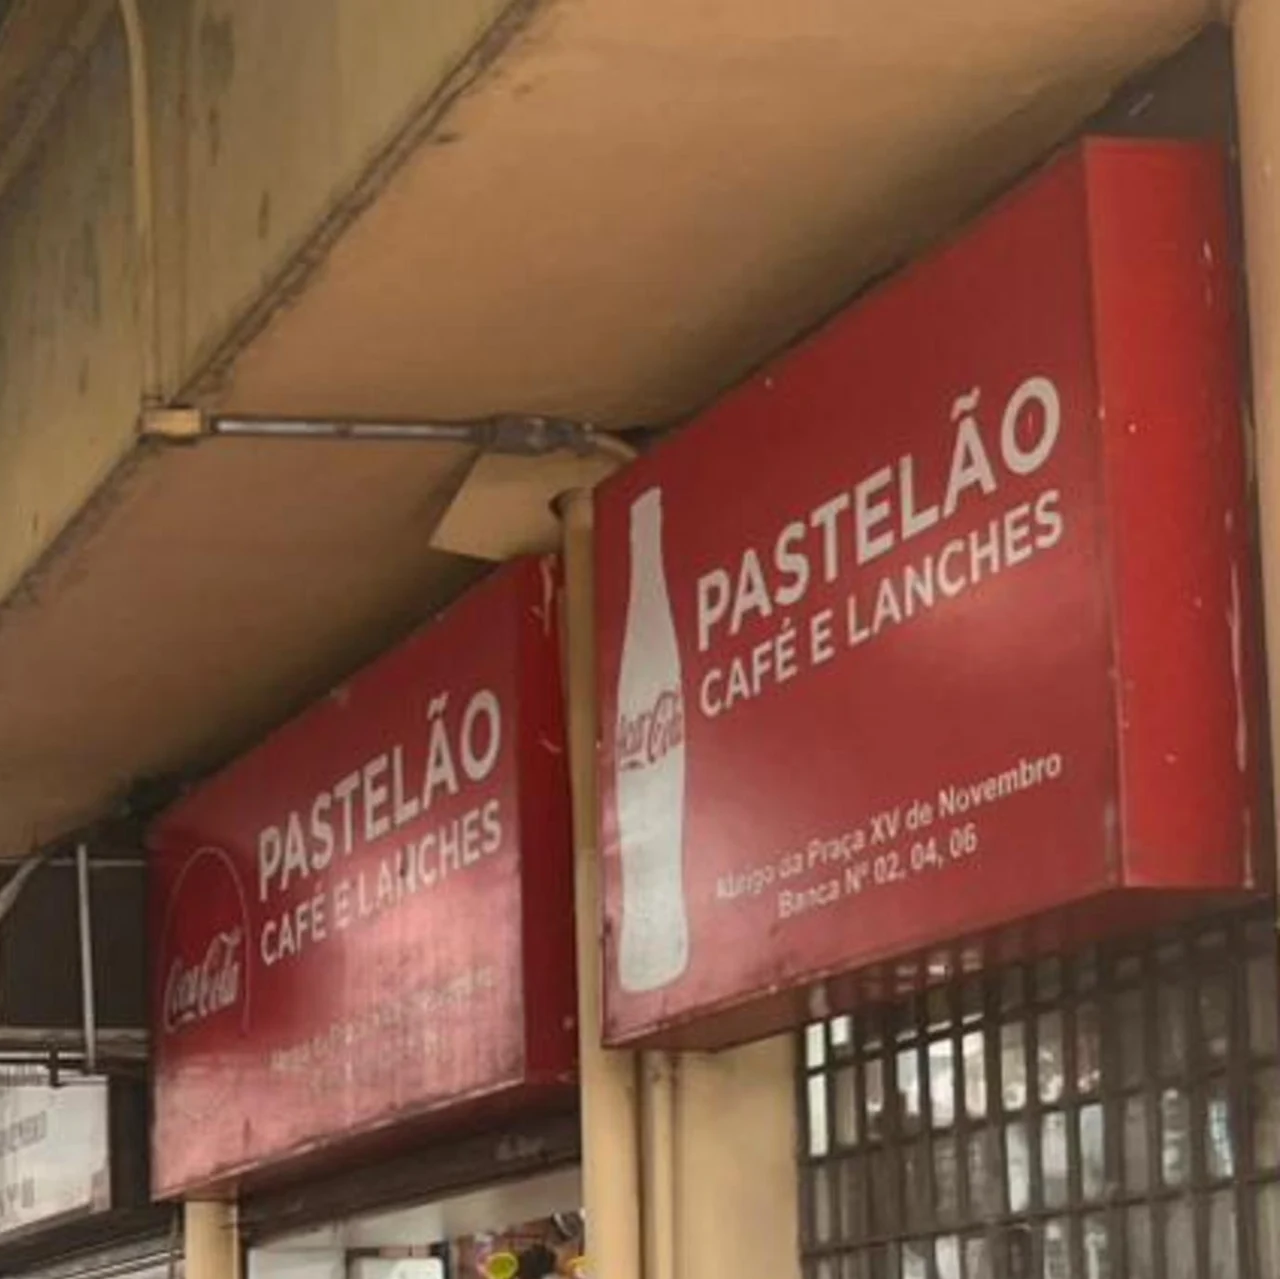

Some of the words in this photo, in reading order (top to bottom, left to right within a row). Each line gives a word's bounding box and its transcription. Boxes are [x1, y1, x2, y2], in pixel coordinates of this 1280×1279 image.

[697, 375, 1062, 653] PASTELÃO
[699, 615, 799, 718] CAFÉ
[809, 608, 837, 666] E
[846, 489, 1065, 648] LANCHES
[258, 688, 502, 903] PASTELÃO
[806, 827, 866, 870] Praça
[869, 807, 901, 846] XV
[905, 797, 934, 832] de
[938, 751, 1063, 818] Novembro
[259, 881, 327, 967] CAFÉ
